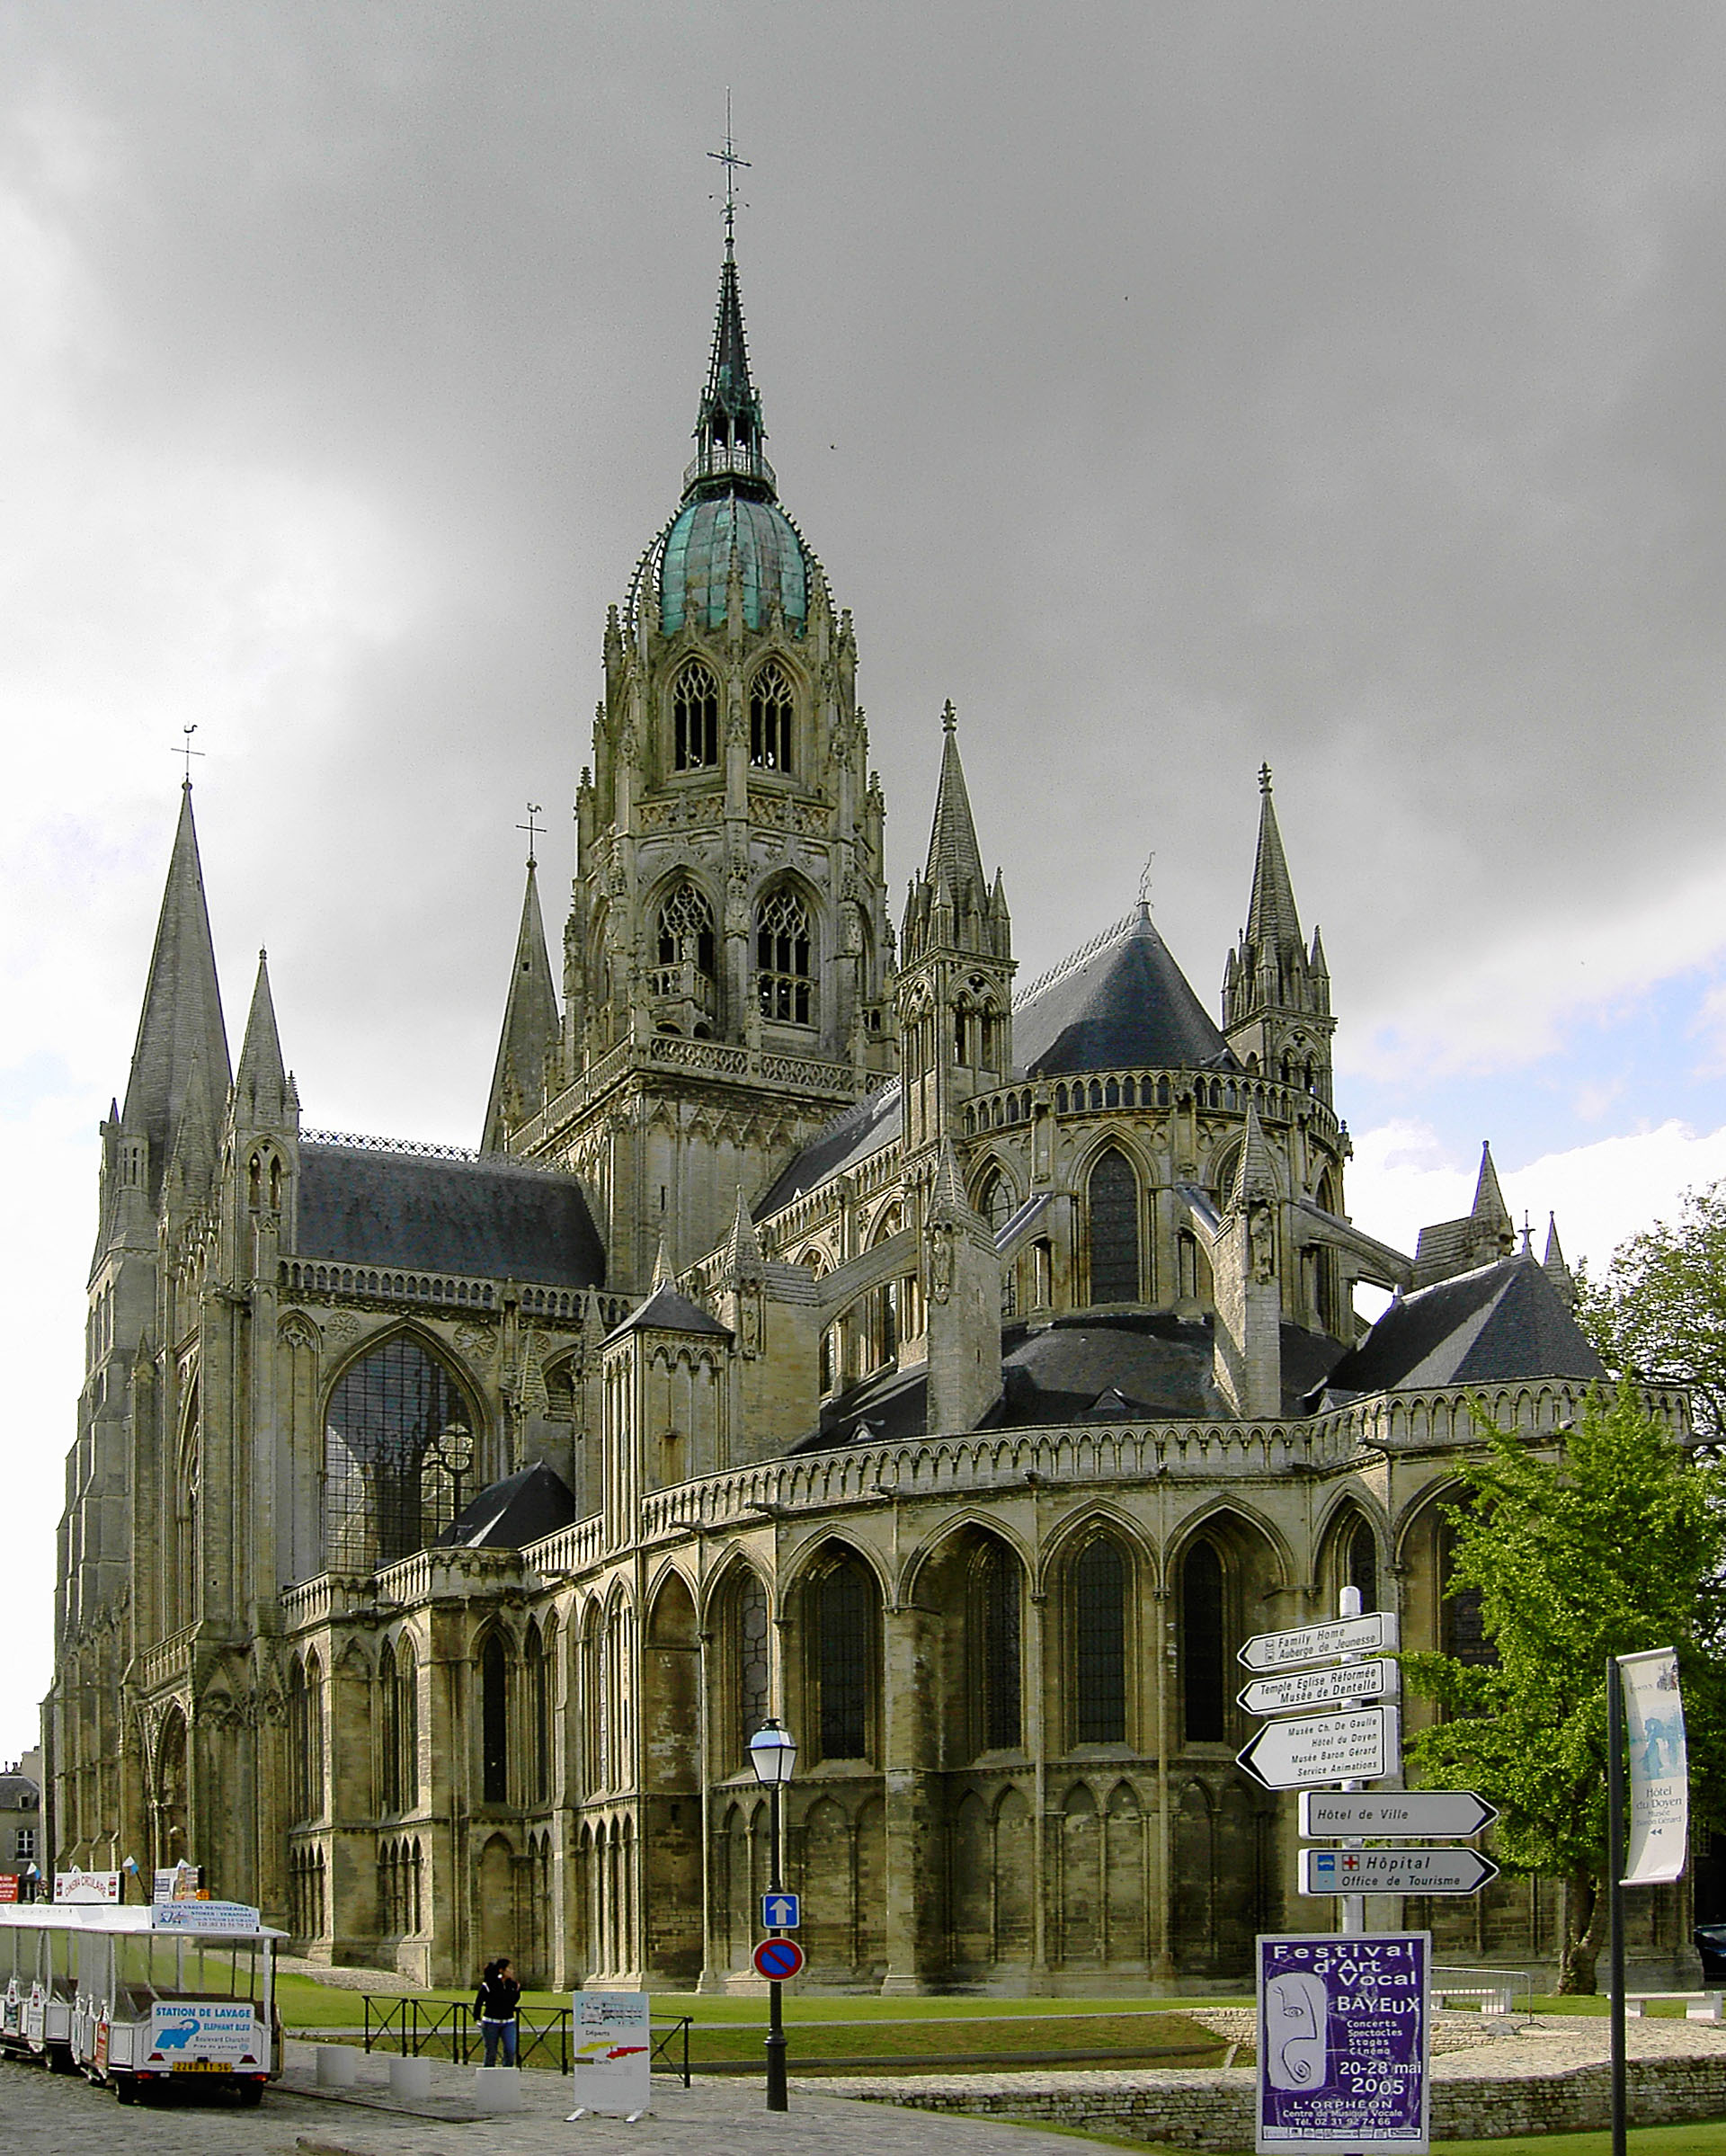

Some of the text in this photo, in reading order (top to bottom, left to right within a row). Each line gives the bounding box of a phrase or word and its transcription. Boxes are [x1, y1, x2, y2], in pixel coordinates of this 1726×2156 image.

[1278, 1628, 1345, 1648] Family Home
[1278, 1635, 1375, 1660] Auberge de Jeunesse
[1260, 1667, 1376, 1695] Temple Eglise Réformée
[1280, 1679, 1376, 1703] Musée de Dentelle
[1288, 1726, 1312, 1735] Musée
[1335, 1722, 1345, 1730] De
[1349, 1718, 1377, 1728] Gaulle
[1312, 1733, 1376, 1746] Hôtel du Doyen
[1291, 1745, 1376, 1763] Musée Baron Gérard
[1297, 1761, 1376, 1777] Service Animations
[1646, 1786, 1671, 1798] Hôtel
[1636, 1798, 1682, 1810] du Doyen
[1317, 1808, 1409, 1819] Hôtel de Ville
[1366, 1857, 1430, 1872] Hôpital
[1341, 1875, 1461, 1886] Office de Tourisme
[1273, 1942, 1413, 1959] Festival
[1313, 1958, 1383, 1973] d'Art
[1337, 1971, 1417, 1986] Vocal
[1337, 1996, 1420, 2014] BAYEUX
[156, 2008, 251, 2018] STATION DE LAVAGE
[1347, 2019, 1398, 2027] Concerts
[1348, 2038, 1390, 2046] Stages
[1349, 2047, 1391, 2055] Cinéma
[1339, 2061, 1421, 2074] 20-28 mai
[1351, 2078, 1404, 2095] 2005
[1283, 2109, 1402, 2119] Centre de Musique Vocale
[1294, 2117, 1311, 2125] Tél.
